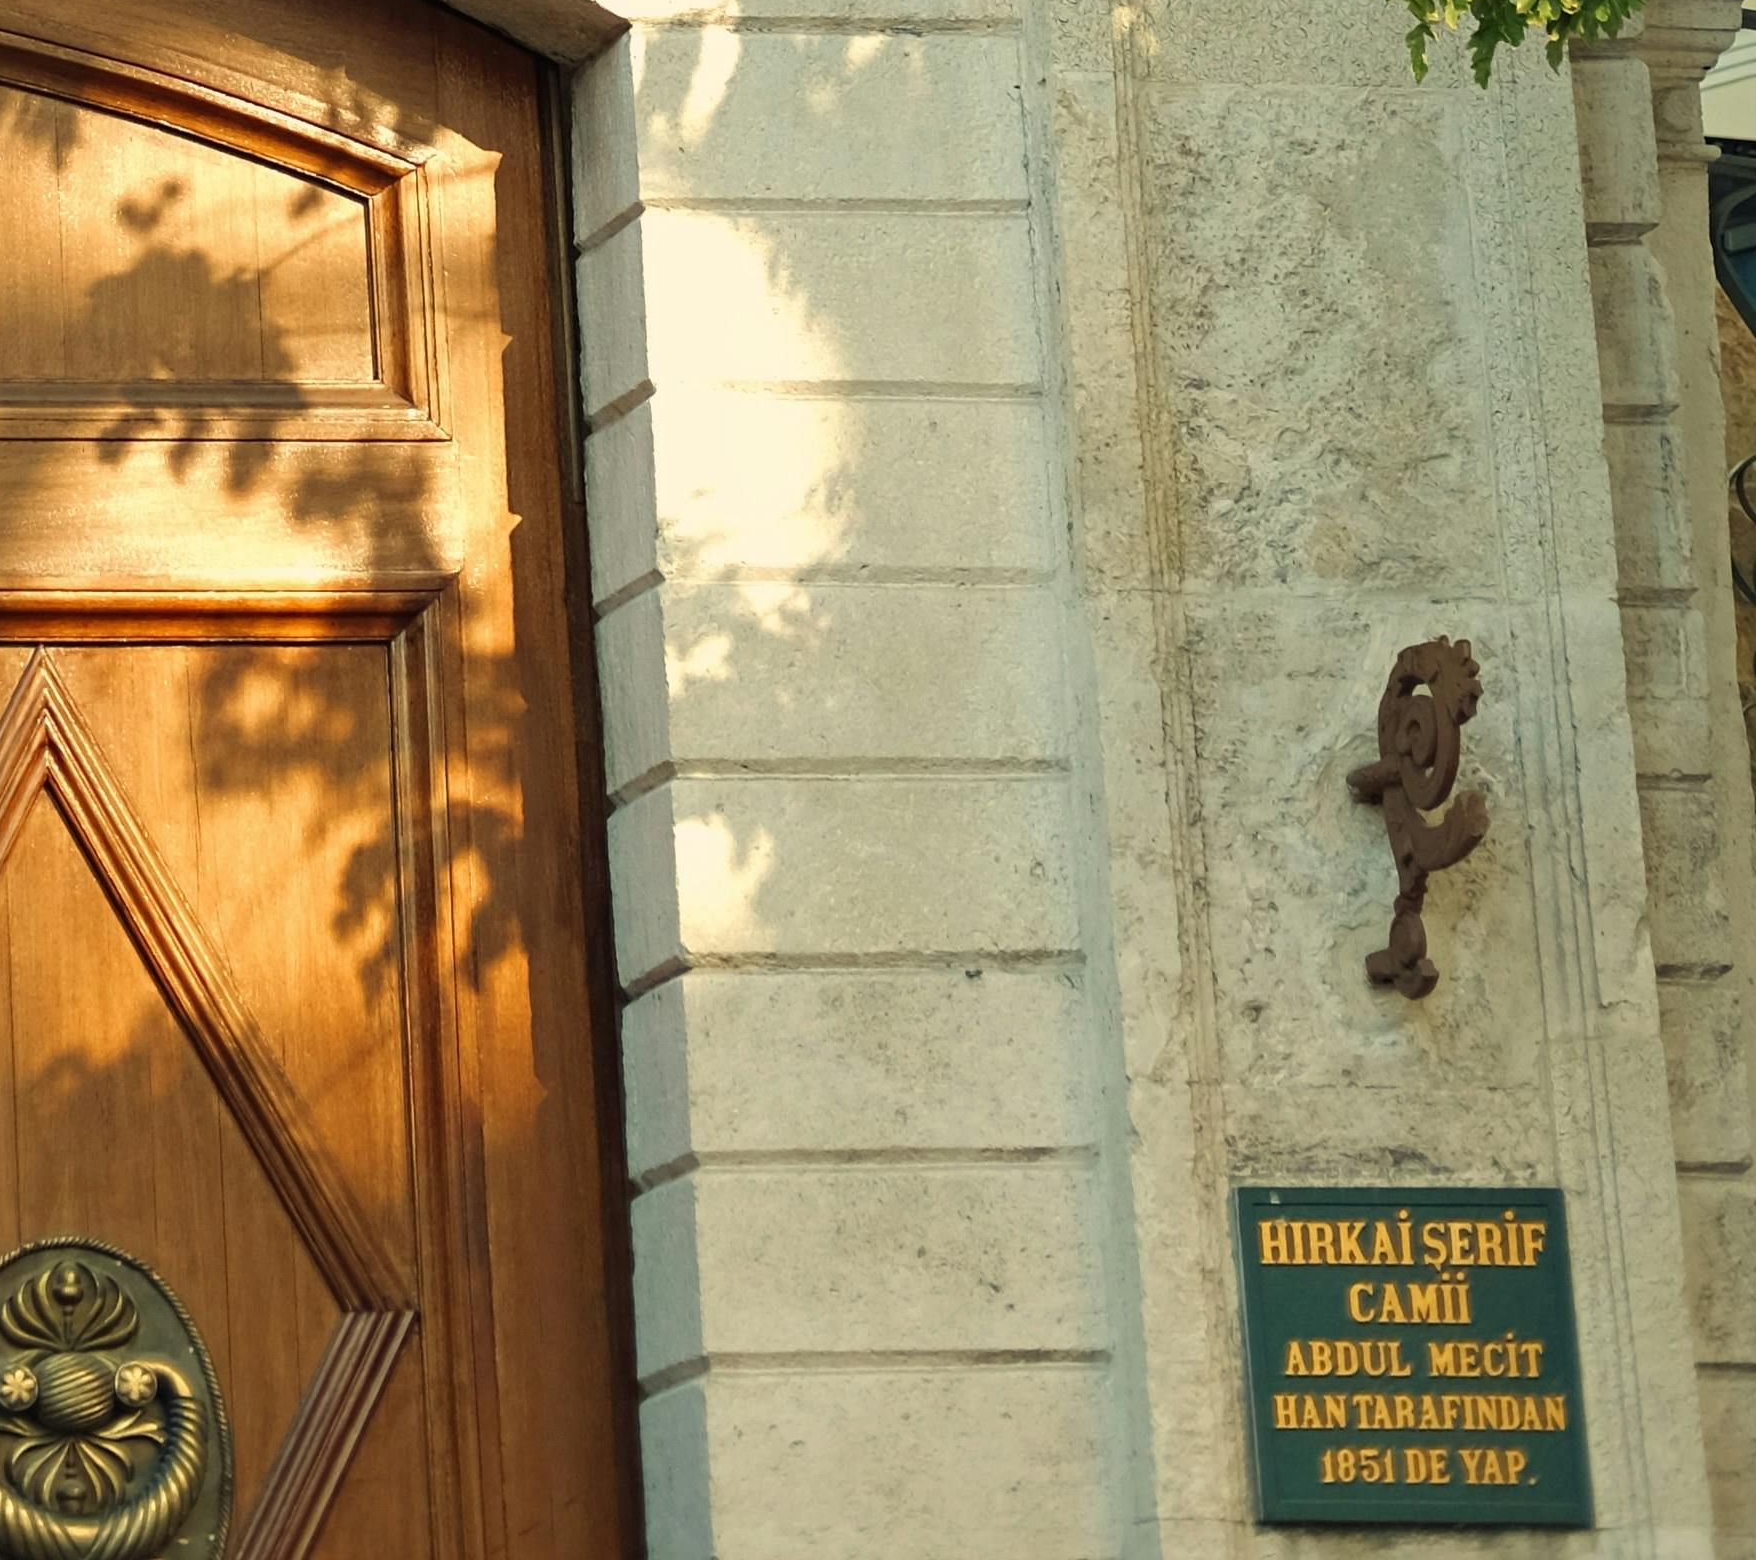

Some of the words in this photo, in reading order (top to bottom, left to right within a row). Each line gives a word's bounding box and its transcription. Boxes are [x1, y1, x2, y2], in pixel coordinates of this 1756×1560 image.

[1258, 1208, 1414, 1265] HIRKAİ
[1421, 1209, 1545, 1271] ŞERİF
[1349, 1271, 1471, 1324] CAMİİ
[1284, 1340, 1411, 1377] ABDUL
[1428, 1331, 1543, 1378] MECİT
[1273, 1394, 1347, 1430] HAN
[1353, 1394, 1566, 1432] TARAFINDAN
[1321, 1448, 1395, 1484] 1851
[1403, 1449, 1449, 1484] DE
